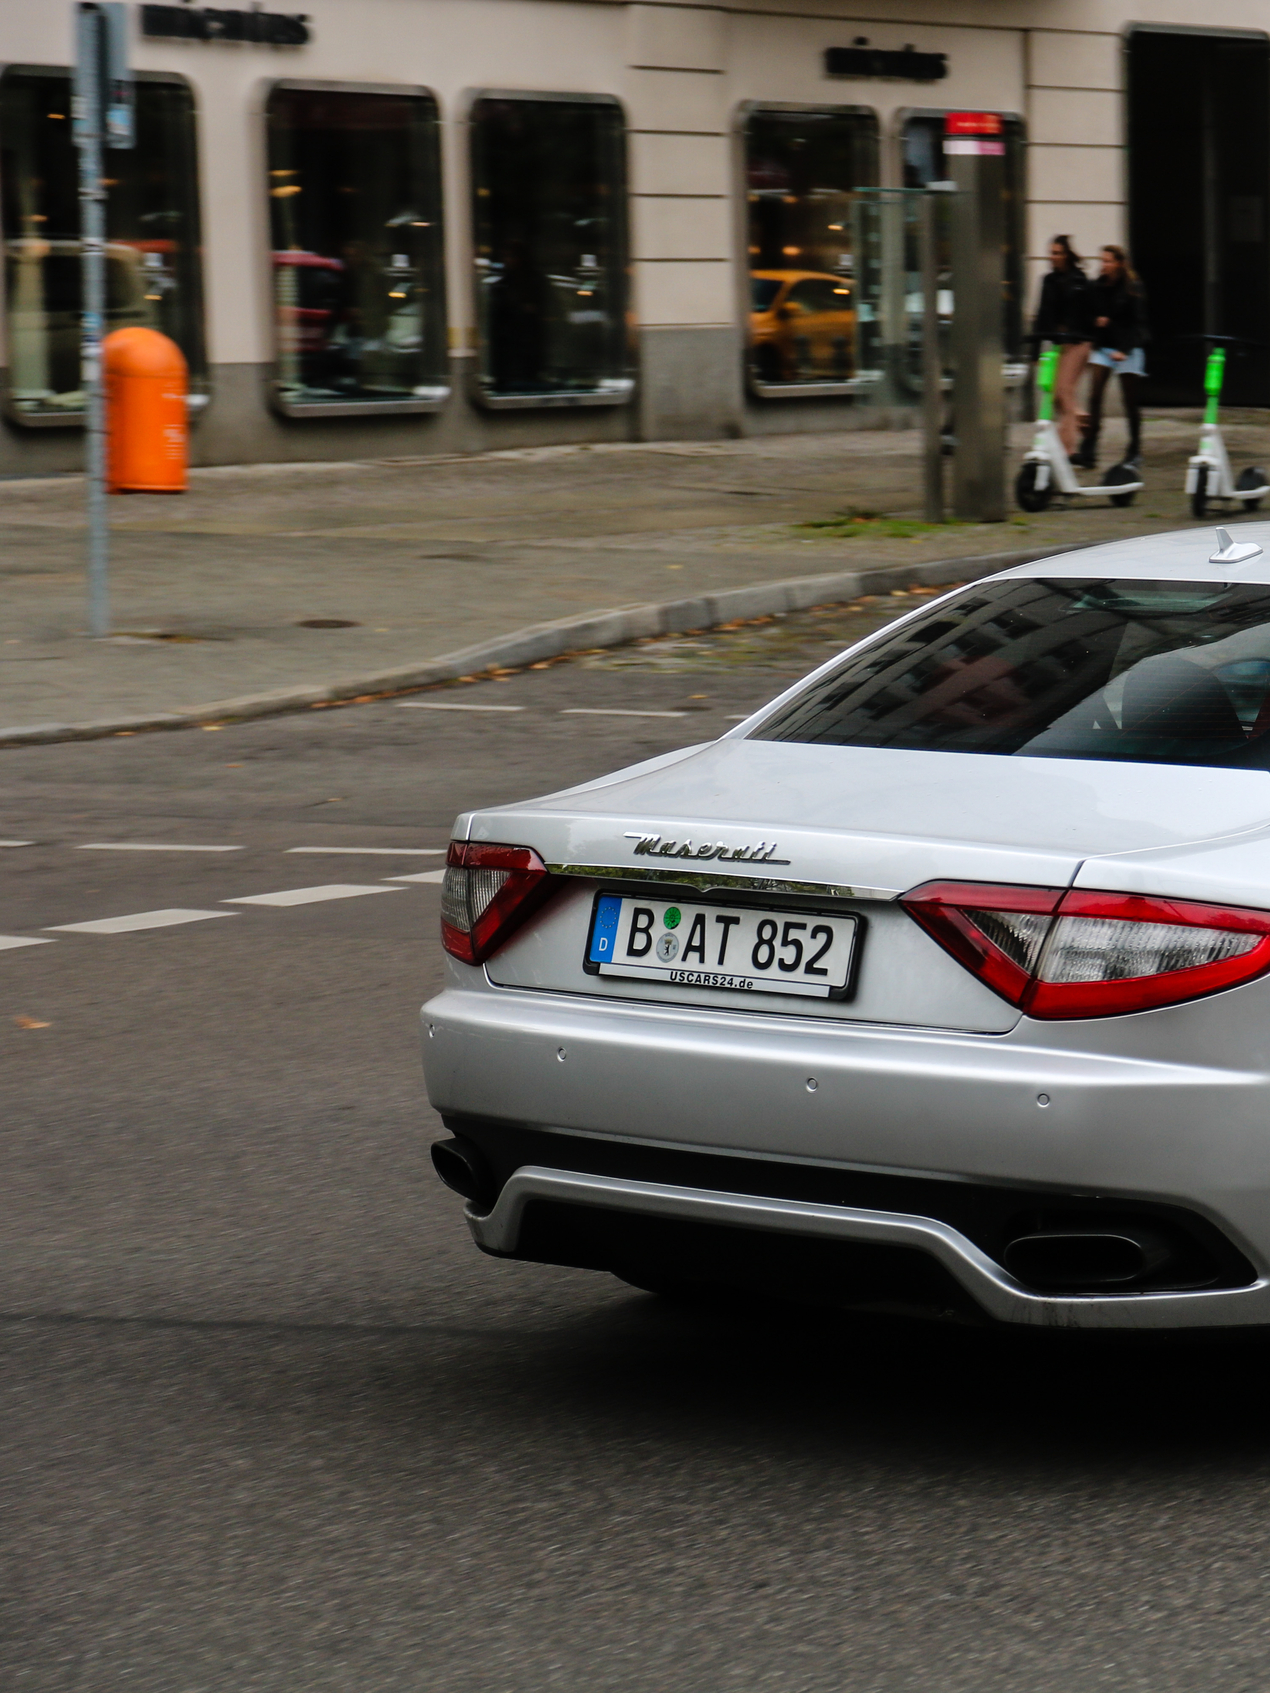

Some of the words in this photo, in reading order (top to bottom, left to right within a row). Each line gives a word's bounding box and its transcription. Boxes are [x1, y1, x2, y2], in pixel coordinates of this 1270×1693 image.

[622, 831, 791, 865] Maserati
[598, 937, 608, 952] D
[626, 906, 655, 958] B
[681, 913, 741, 966] AT
[751, 918, 834, 977] 852
[669, 971, 754, 990] USCARS24.de
